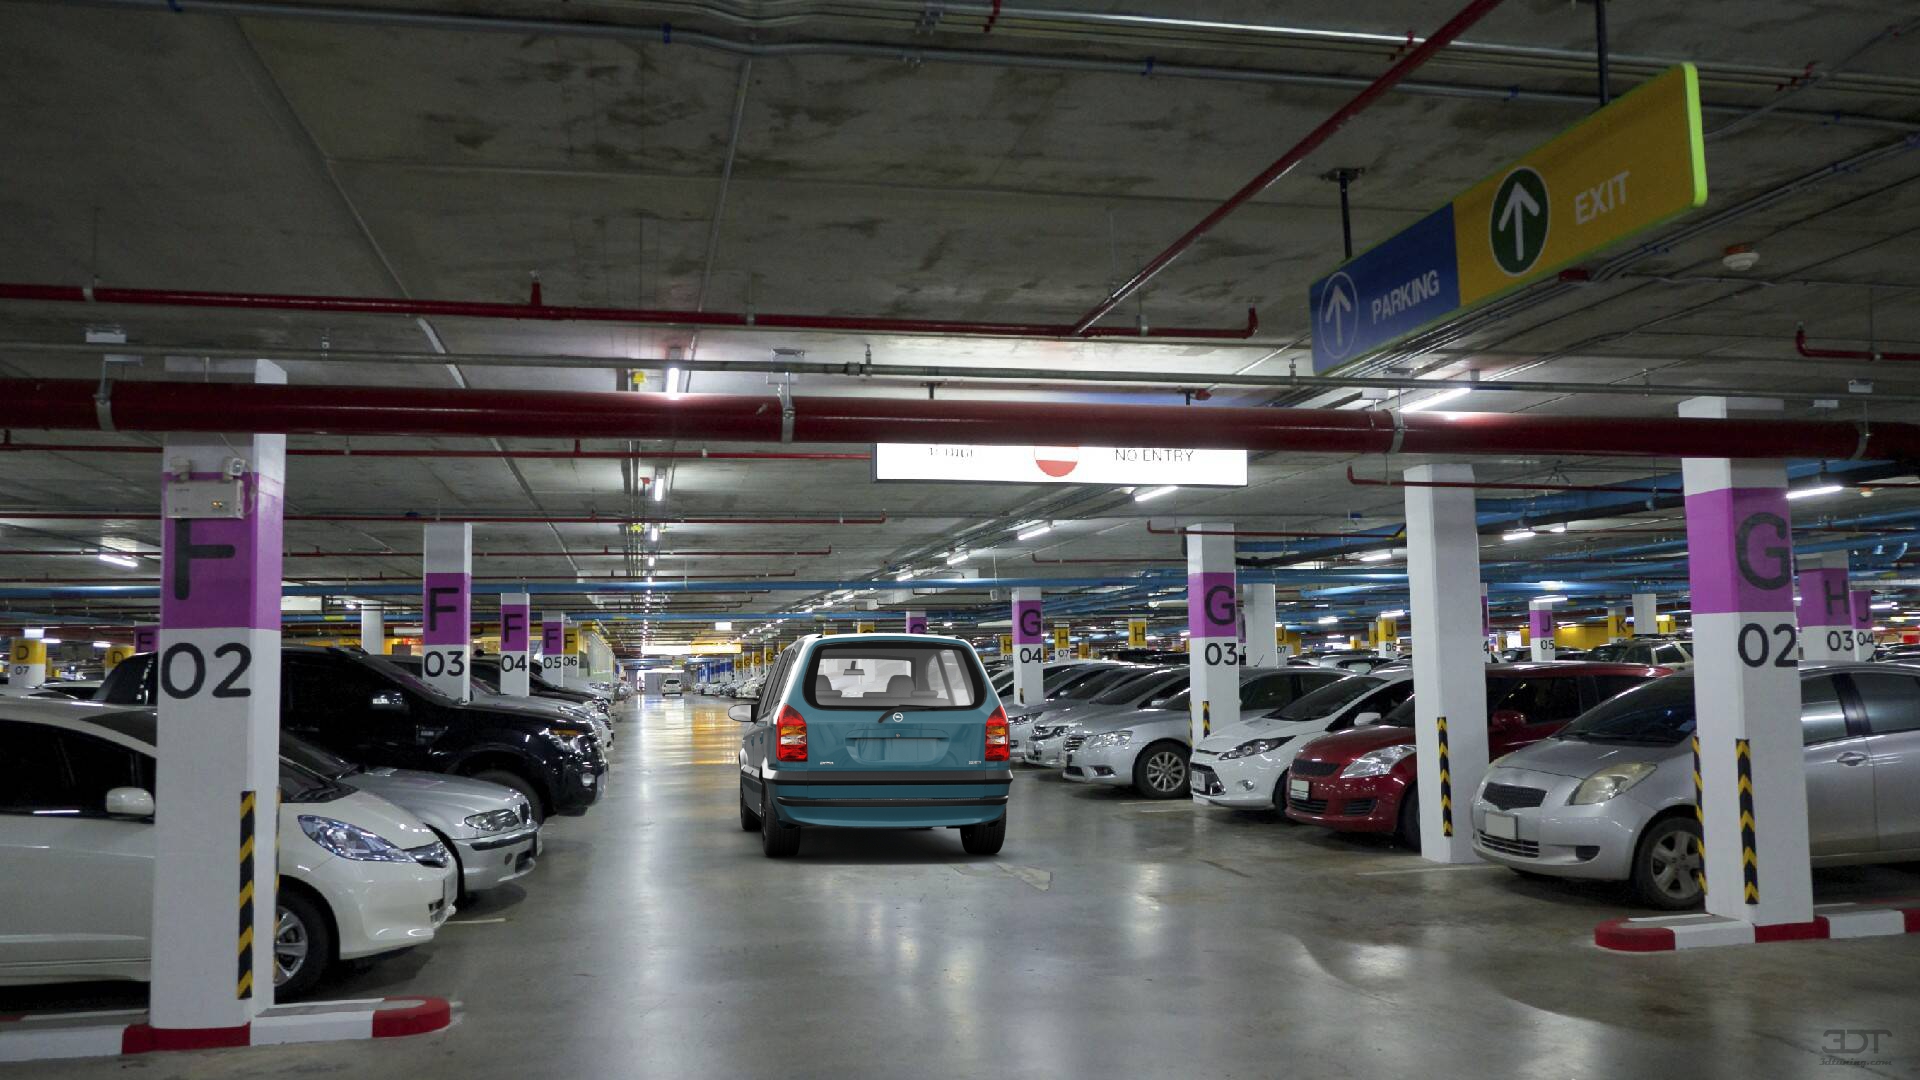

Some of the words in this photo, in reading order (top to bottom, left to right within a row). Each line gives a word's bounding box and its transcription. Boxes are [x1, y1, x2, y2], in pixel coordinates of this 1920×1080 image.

[1575, 171, 1630, 226] EXIT
[1371, 270, 1440, 325] PARKING
[1115, 449, 1137, 461] NO
[1143, 449, 1194, 462] ENTRY
[174, 517, 236, 601] F
[1736, 512, 1791, 590] G
[1205, 585, 1236, 625] G
[1824, 580, 1849, 616] H
[430, 587, 459, 632] F
[1858, 598, 1869, 622] J
[504, 614, 523, 643] F
[1020, 609, 1042, 636] G
[1386, 623, 1395, 637] J
[1541, 616, 1551, 632] J
[1616, 618, 1626, 633] K
[545, 629, 559, 649] F
[564, 634, 574, 649] F
[1058, 629, 1068, 643] H
[1133, 626, 1146, 641] H
[1827, 631, 1855, 651] 03
[1857, 632, 1873, 646] 04
[16, 645, 29, 660] D
[1003, 640, 1013, 651] H
[1540, 639, 1554, 650] 05
[1738, 623, 1797, 667] 02
[501, 655, 528, 672] 04
[543, 657, 562, 669] 05
[563, 656, 578, 667] 06
[1020, 648, 1042, 664] 04
[1205, 643, 1238, 666] 03
[15, 666, 29, 676] 07
[161, 642, 252, 700] 02
[424, 651, 465, 677] 03
